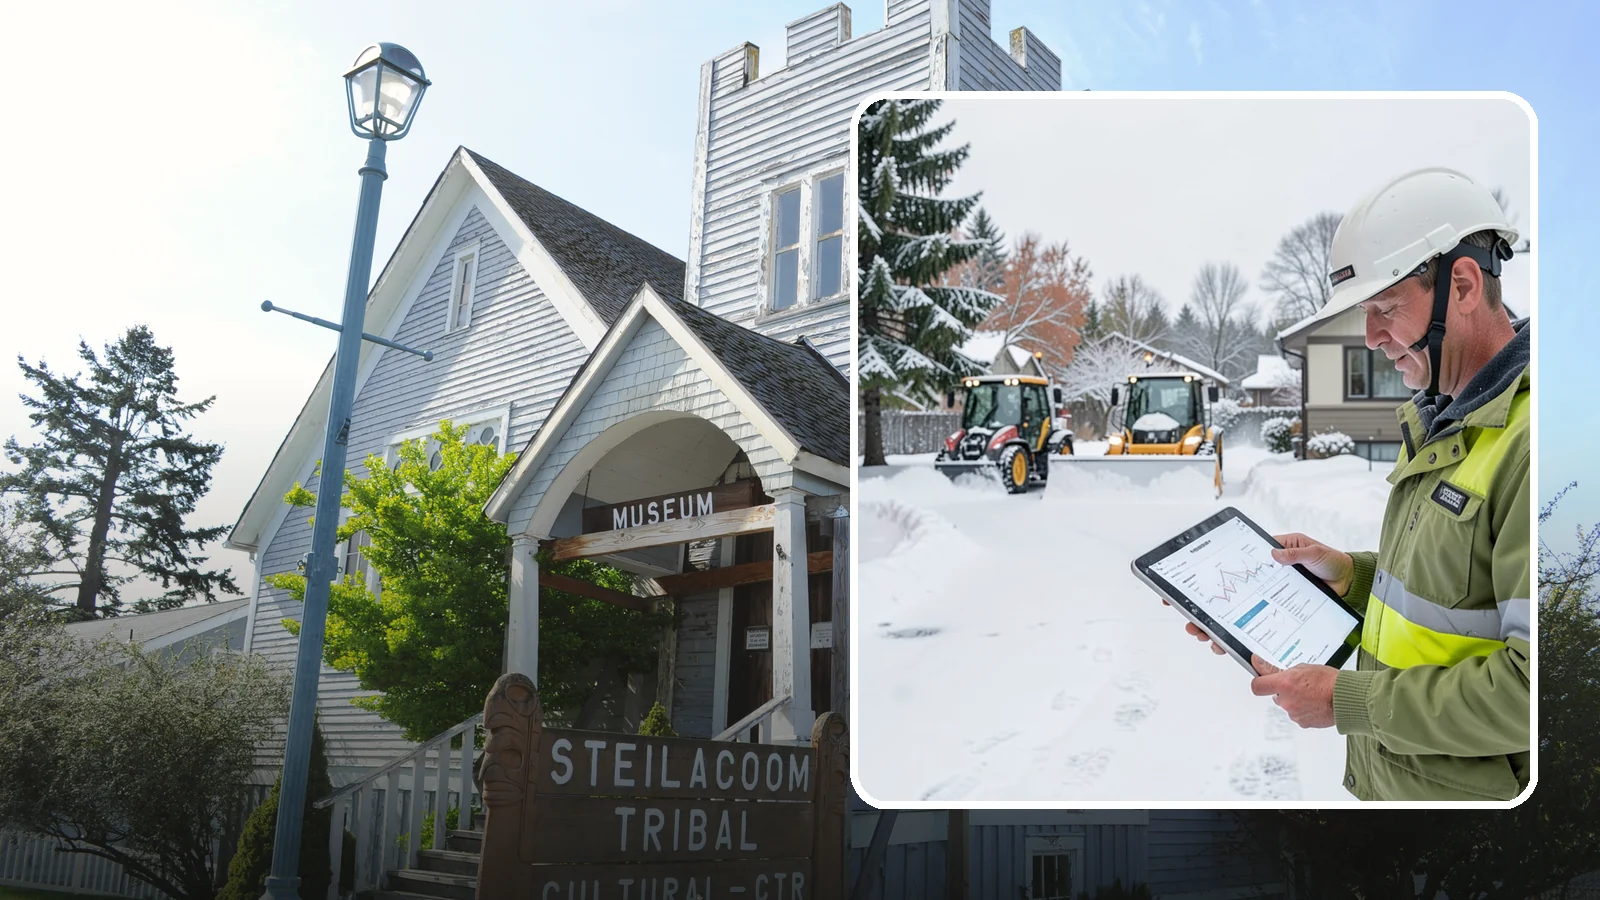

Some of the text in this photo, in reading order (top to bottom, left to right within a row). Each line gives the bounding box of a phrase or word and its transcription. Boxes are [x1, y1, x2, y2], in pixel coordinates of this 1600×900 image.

[613, 491, 713, 530] MUSEUM
[550, 738, 809, 793] STEILACOOM
[615, 806, 757, 852] TRIBAL
